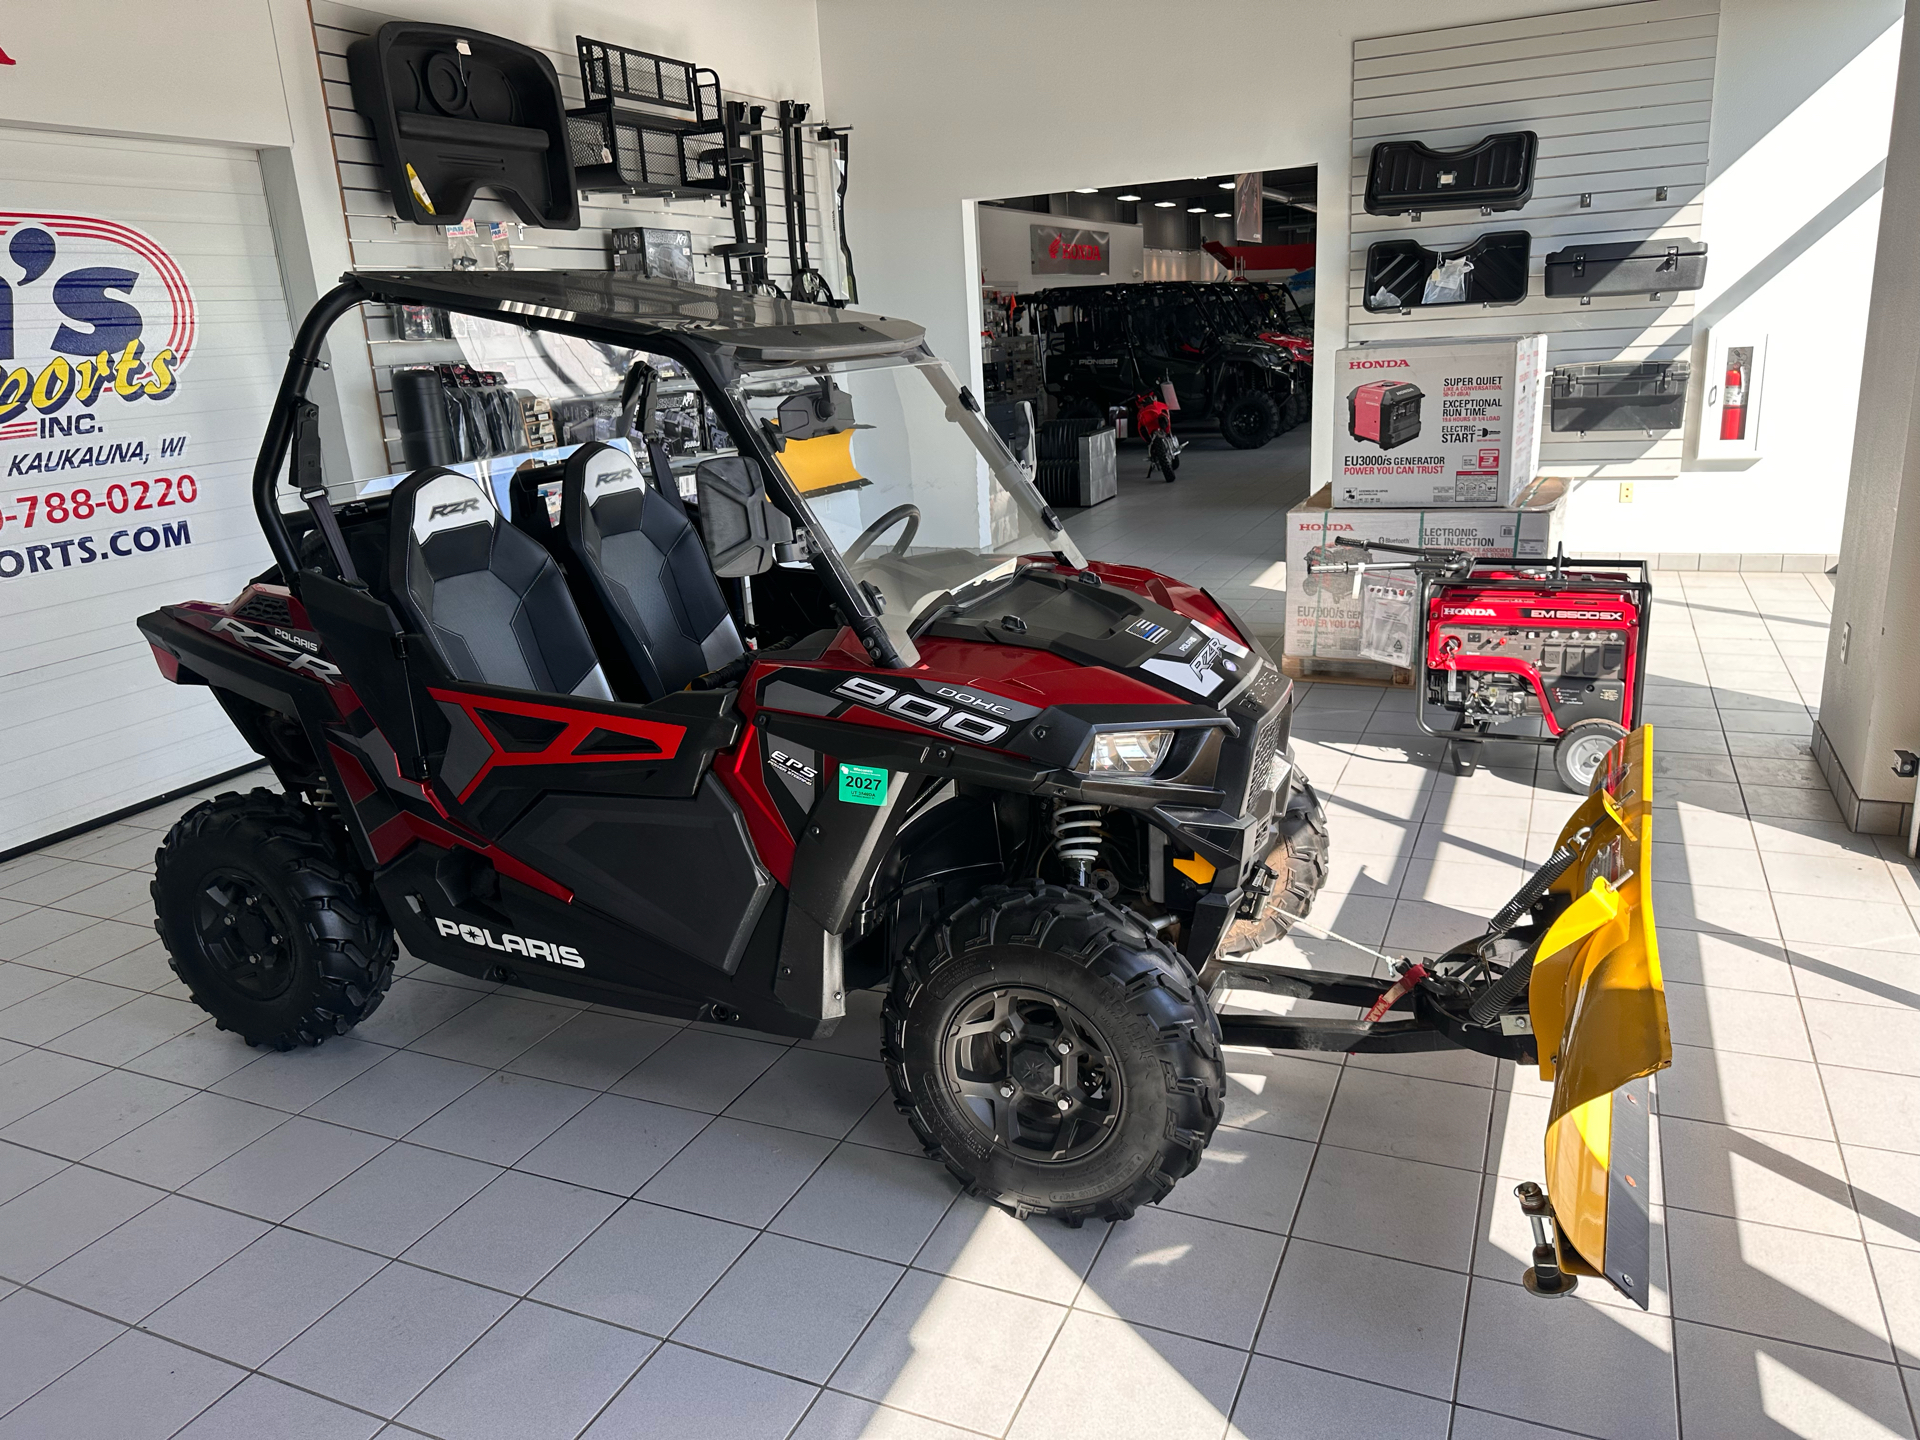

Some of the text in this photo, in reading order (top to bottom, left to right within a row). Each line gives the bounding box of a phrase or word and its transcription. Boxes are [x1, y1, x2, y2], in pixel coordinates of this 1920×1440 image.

[1062, 243, 1102, 261] HONDA
[1349, 359, 1410, 370] HONDA
[1443, 376, 1503, 387] SUPER QUIET
[1443, 399, 1502, 408] EXCEPTIONAL
[1442, 408, 1487, 417] RUN TIME
[40, 413, 103, 439] INC.
[1442, 425, 1476, 433] ELECTRIC
[1441, 433, 1475, 443] START
[8, 437, 186, 477] KAUKAUNA, WI
[1344, 455, 1445, 466] EU3000is GENERATOR
[595, 468, 633, 488] RZR
[1344, 465, 1444, 475] POWER YOU CAN TRUST
[0, 474, 197, 531] -788-0220
[428, 497, 480, 522] RZR
[1299, 523, 1354, 531] HONDA
[0, 520, 191, 578] ORTS.COM
[1418, 537, 1494, 547] UEL INJECTION
[1443, 608, 1496, 617] HONDA
[1329, 619, 1347, 628] YOU
[274, 627, 318, 652] POLARIS
[1178, 636, 1198, 652] POLARIS
[210, 617, 342, 686] RZR
[1190, 638, 1228, 684] RZR
[936, 687, 1011, 715] DOHC
[833, 676, 1009, 744] 900
[771, 750, 818, 778] EPS
[845, 775, 882, 791] 2027
[434, 917, 586, 969] POLARIS
